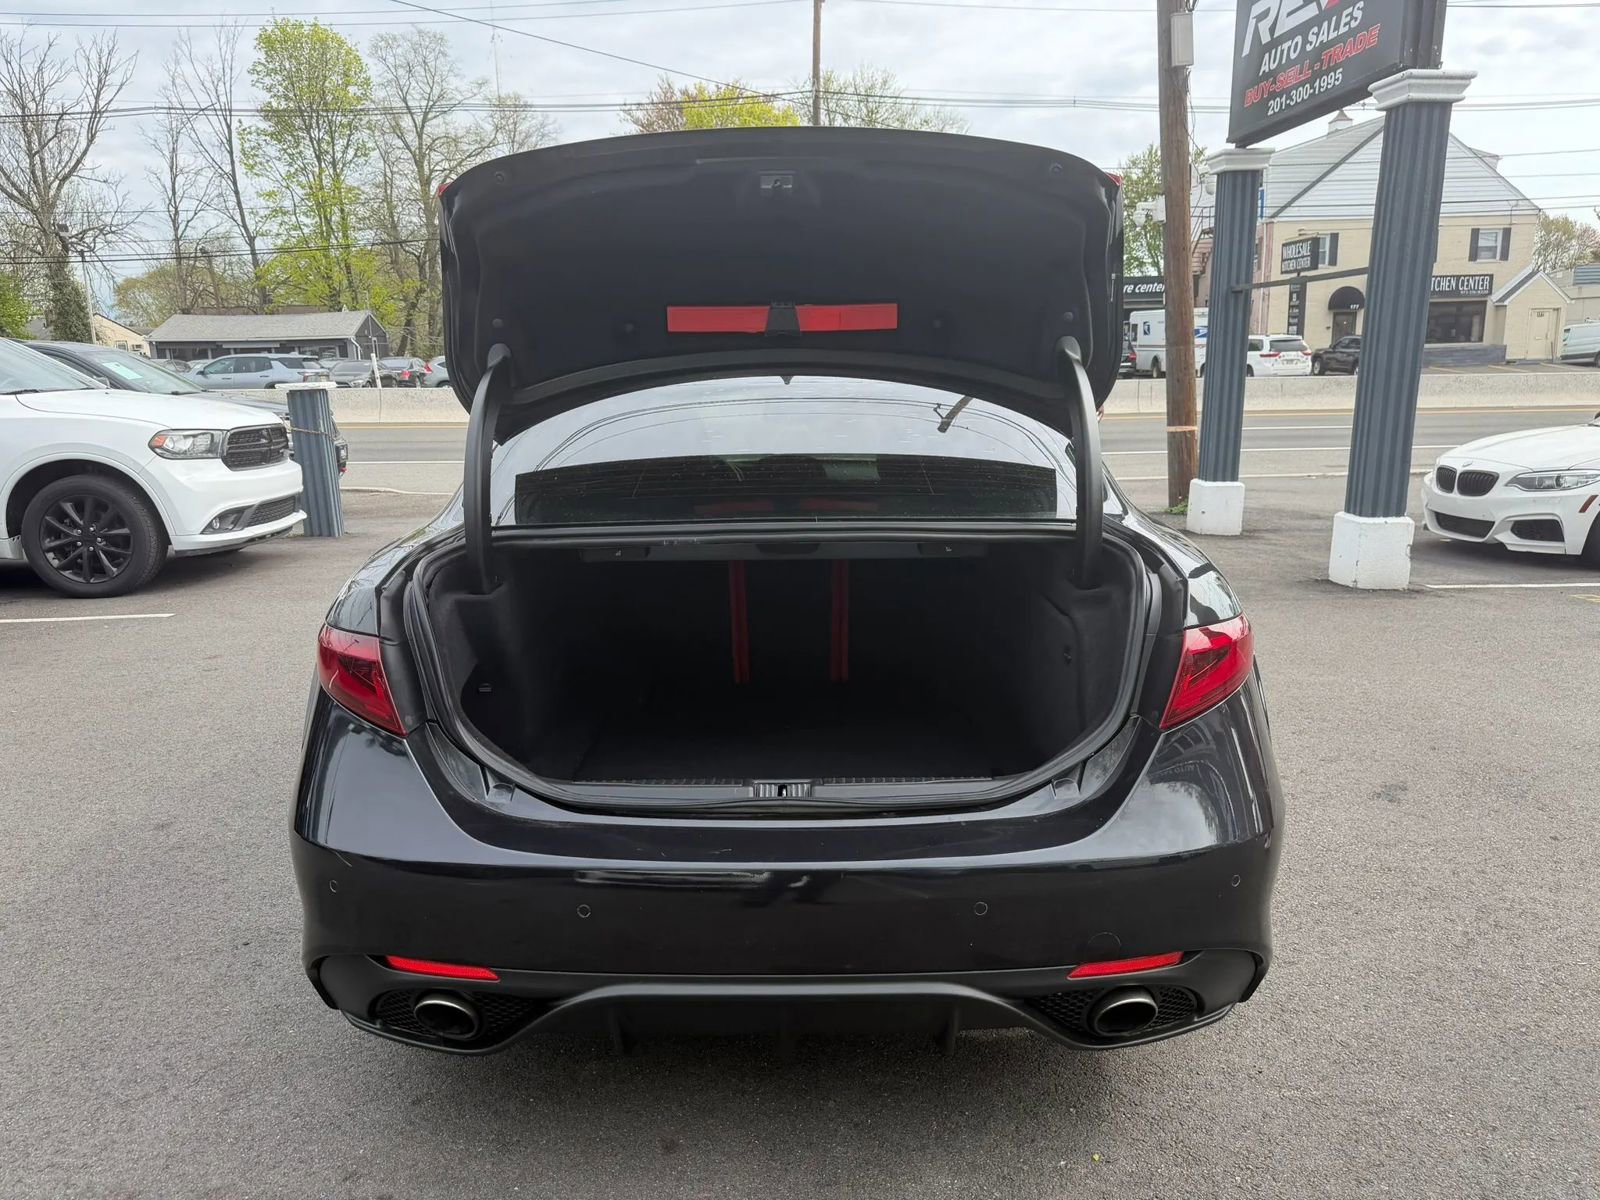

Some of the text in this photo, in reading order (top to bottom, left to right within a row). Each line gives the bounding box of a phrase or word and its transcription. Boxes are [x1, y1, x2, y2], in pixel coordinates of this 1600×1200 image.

[1242, 0, 1339, 57] RE
[1260, 1, 1364, 76] AUTO SALES
[1267, 67, 1343, 116] 201-300-1995
[1458, 276, 1490, 290] CENTER
